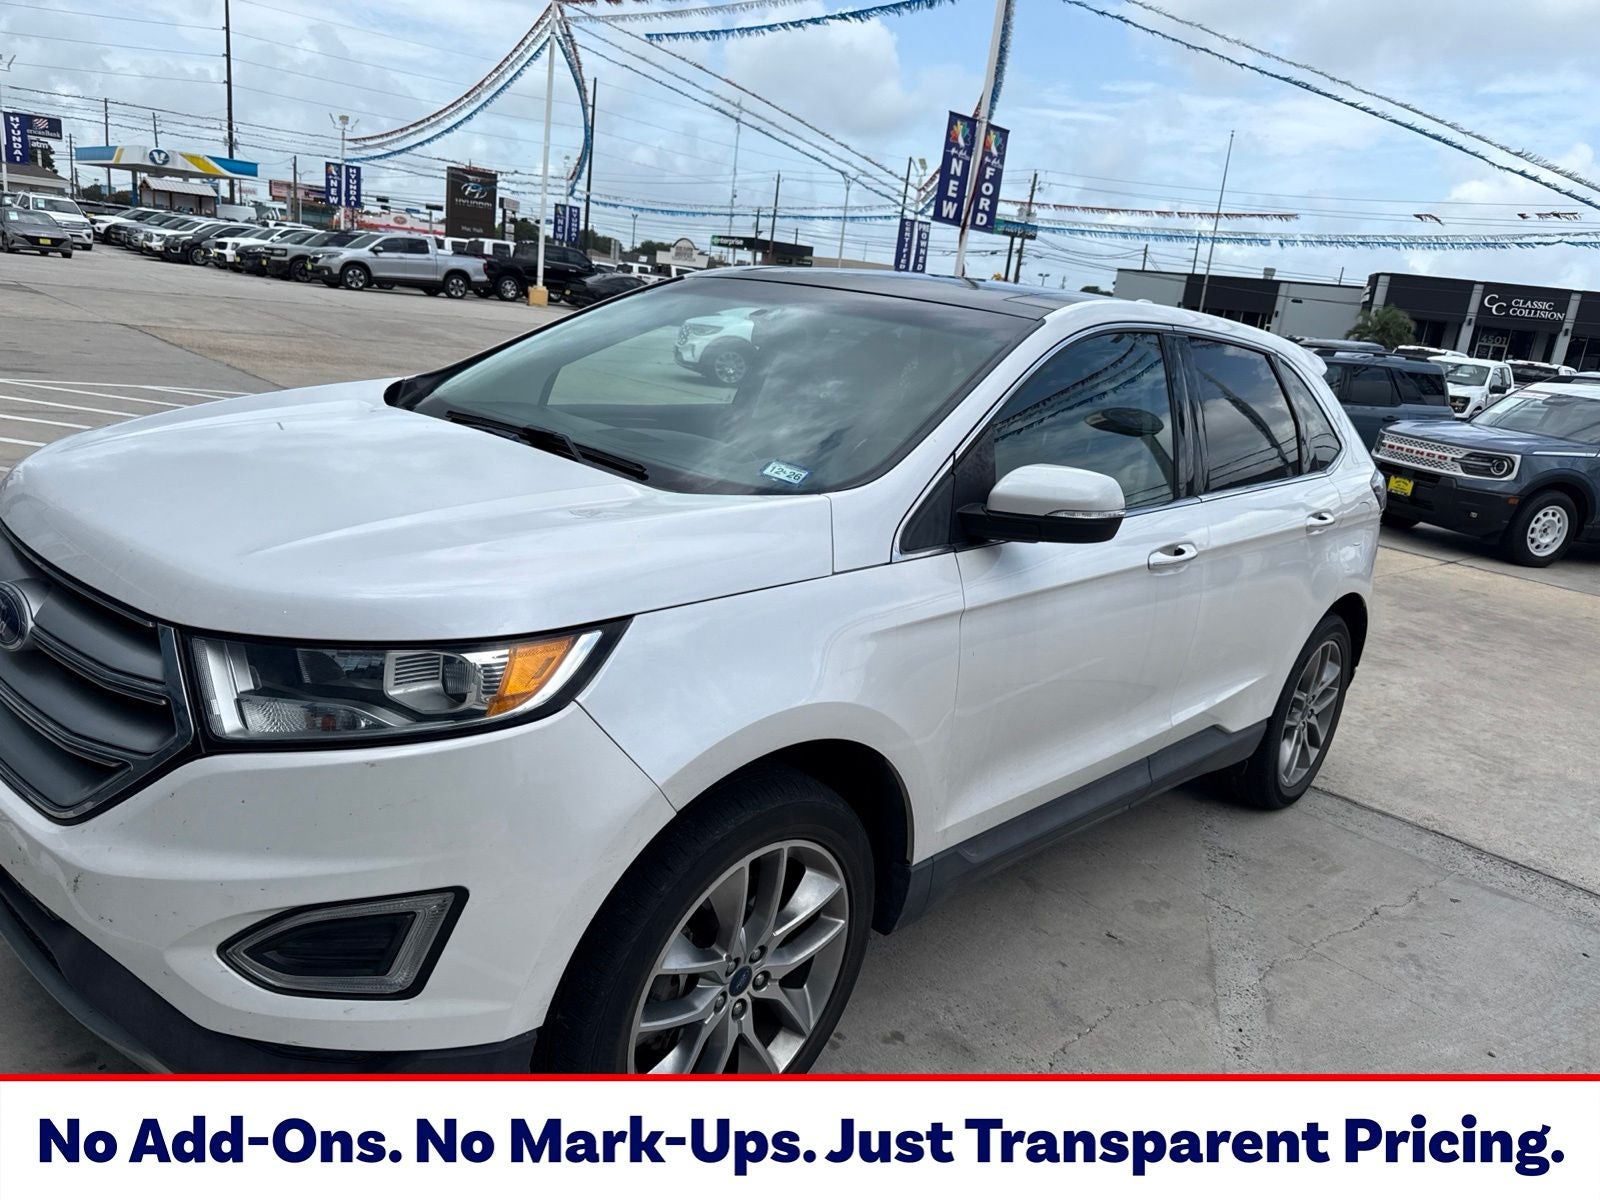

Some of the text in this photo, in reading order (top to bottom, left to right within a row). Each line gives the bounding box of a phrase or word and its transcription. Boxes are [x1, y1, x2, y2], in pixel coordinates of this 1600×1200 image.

[10, 116, 22, 162] HYUNDAI
[31, 141, 49, 149] atm
[328, 180, 339, 205] NEW
[349, 168, 357, 206] HYUNDAI
[941, 158, 963, 219] NEW
[975, 166, 996, 226] FORD
[916, 233, 928, 271] OWNED
[1509, 308, 1566, 321] COLLISION
[1511, 298, 1554, 311] CLASSIC
[1481, 335, 1507, 345] 4501
[1387, 443, 1448, 460] BRONCO
